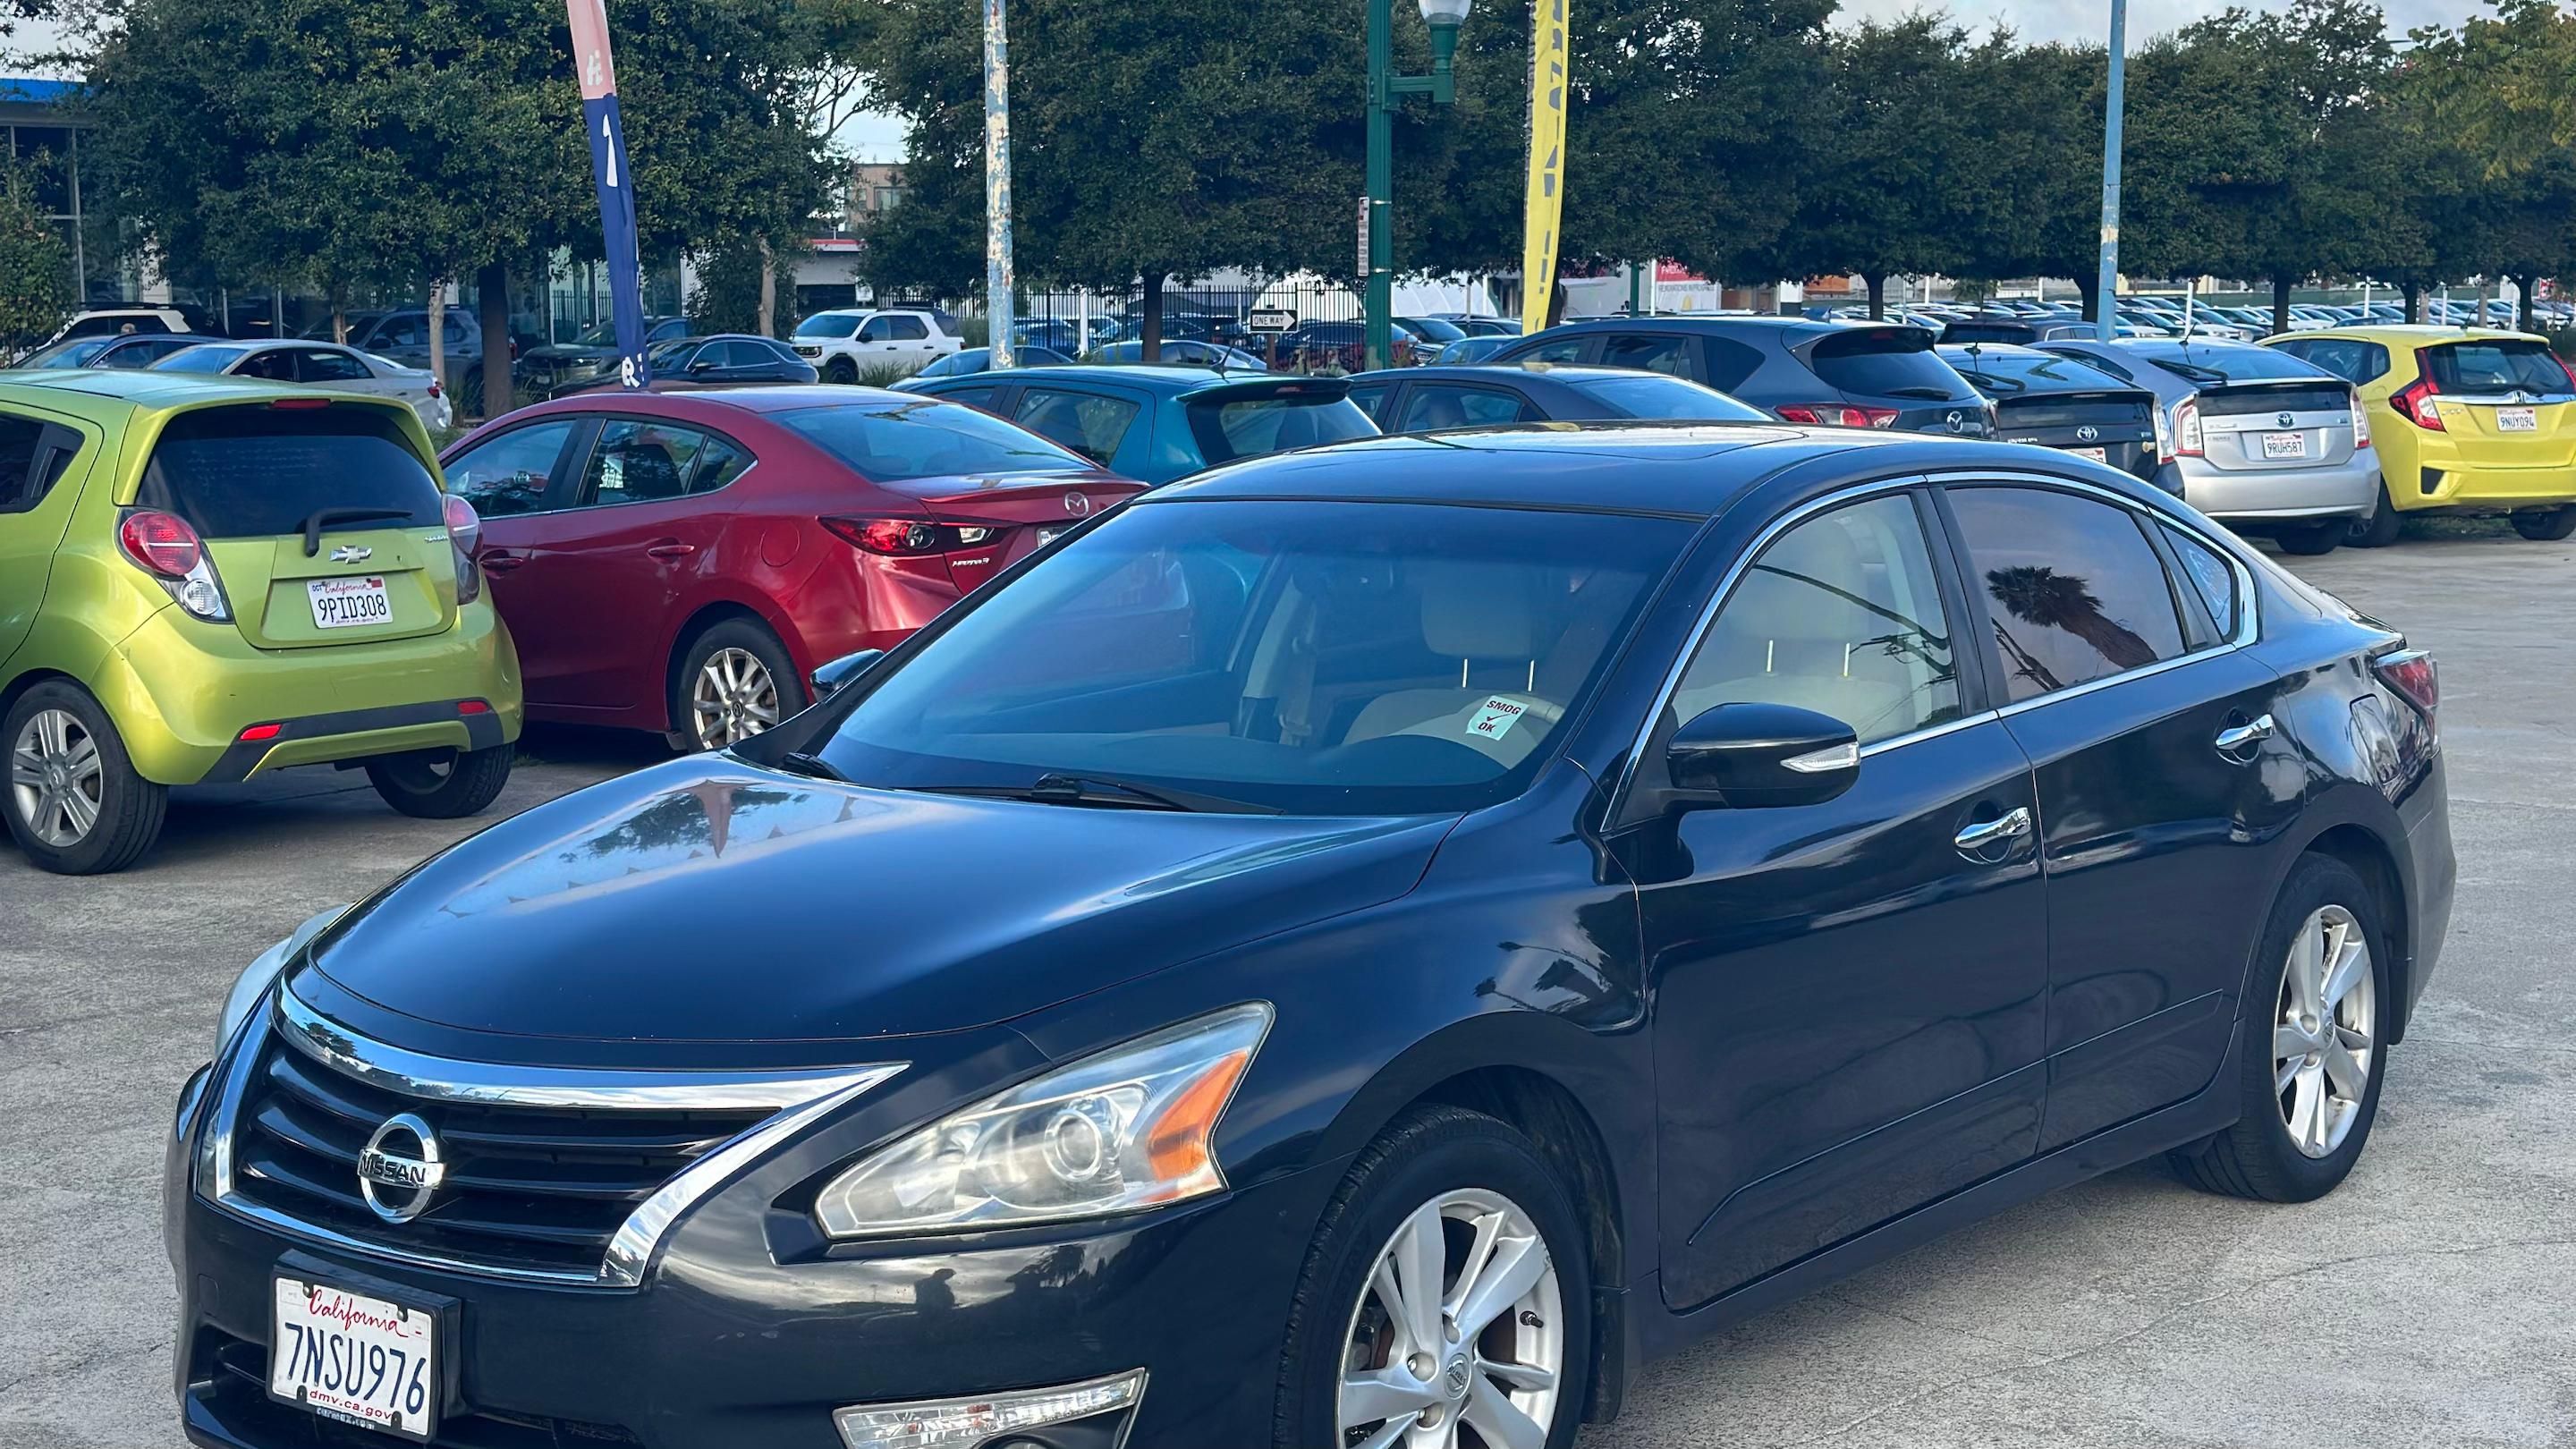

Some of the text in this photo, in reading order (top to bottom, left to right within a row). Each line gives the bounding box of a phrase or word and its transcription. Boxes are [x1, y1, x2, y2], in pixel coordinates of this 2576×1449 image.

[1254, 316, 1284, 326] ONE WAY
[2267, 441, 2302, 454] 9RUH587
[324, 581, 371, 596] California
[318, 594, 386, 623] 9PID308
[1487, 699, 1521, 716] SMOG
[1478, 722, 1496, 733] OK
[309, 1289, 408, 1338] California
[284, 1321, 427, 1415] 7NSU976
[309, 1390, 393, 1419] dmv.ca.gov
